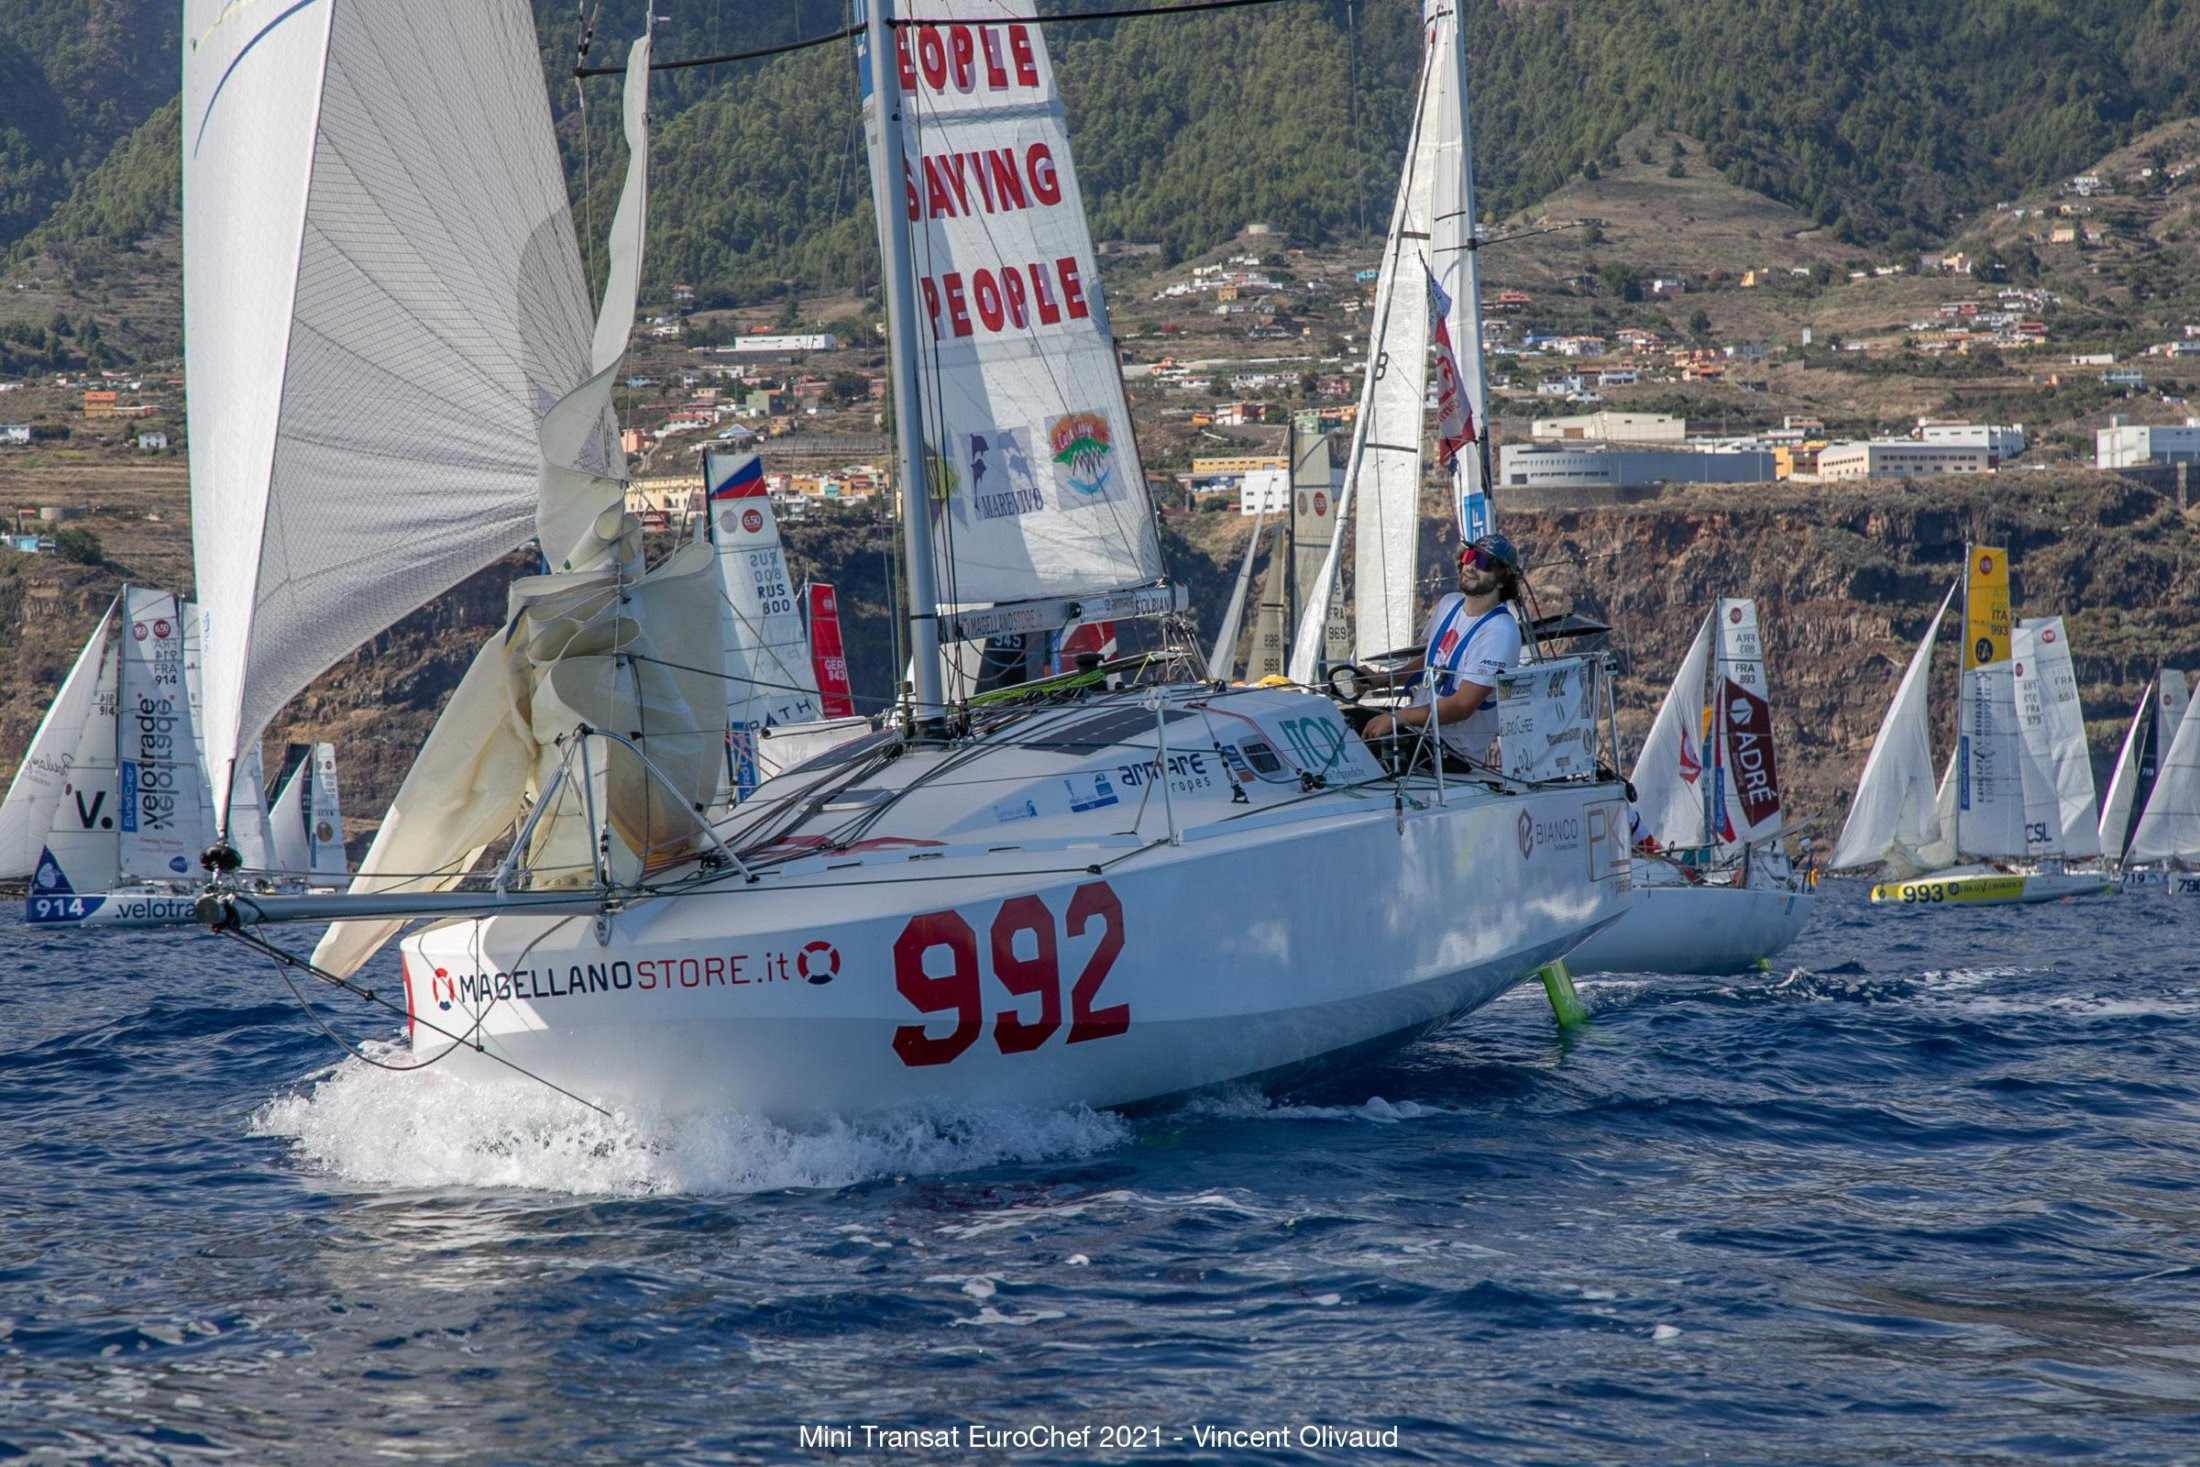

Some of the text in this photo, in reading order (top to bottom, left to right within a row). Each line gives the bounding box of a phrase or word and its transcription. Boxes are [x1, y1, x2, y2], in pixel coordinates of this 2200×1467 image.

[921, 256, 1089, 341] PEOPLE
[981, 487, 1044, 519] MAREVIVO
[757, 584, 785, 599] RUS
[762, 599, 790, 615] 800
[1328, 626, 1346, 640] 969
[154, 664, 177, 674] FRA
[1264, 658, 1280, 672] 969
[1480, 659, 1507, 668] MUSTO
[1735, 663, 1755, 673] FRA
[155, 674, 177, 685] 914
[1736, 731, 1778, 806] ADRÉ
[1170, 775, 1212, 794] ropes
[1536, 818, 1578, 844] BIANCO
[2026, 822, 2052, 843] CSL
[2122, 872, 2146, 884] 719
[1903, 884, 1944, 904] 993
[36, 898, 84, 918] 914
[115, 898, 196, 919] .velotra
[459, 952, 790, 1003] MAGELLANOSTORE.it
[892, 881, 1130, 1067] 992
